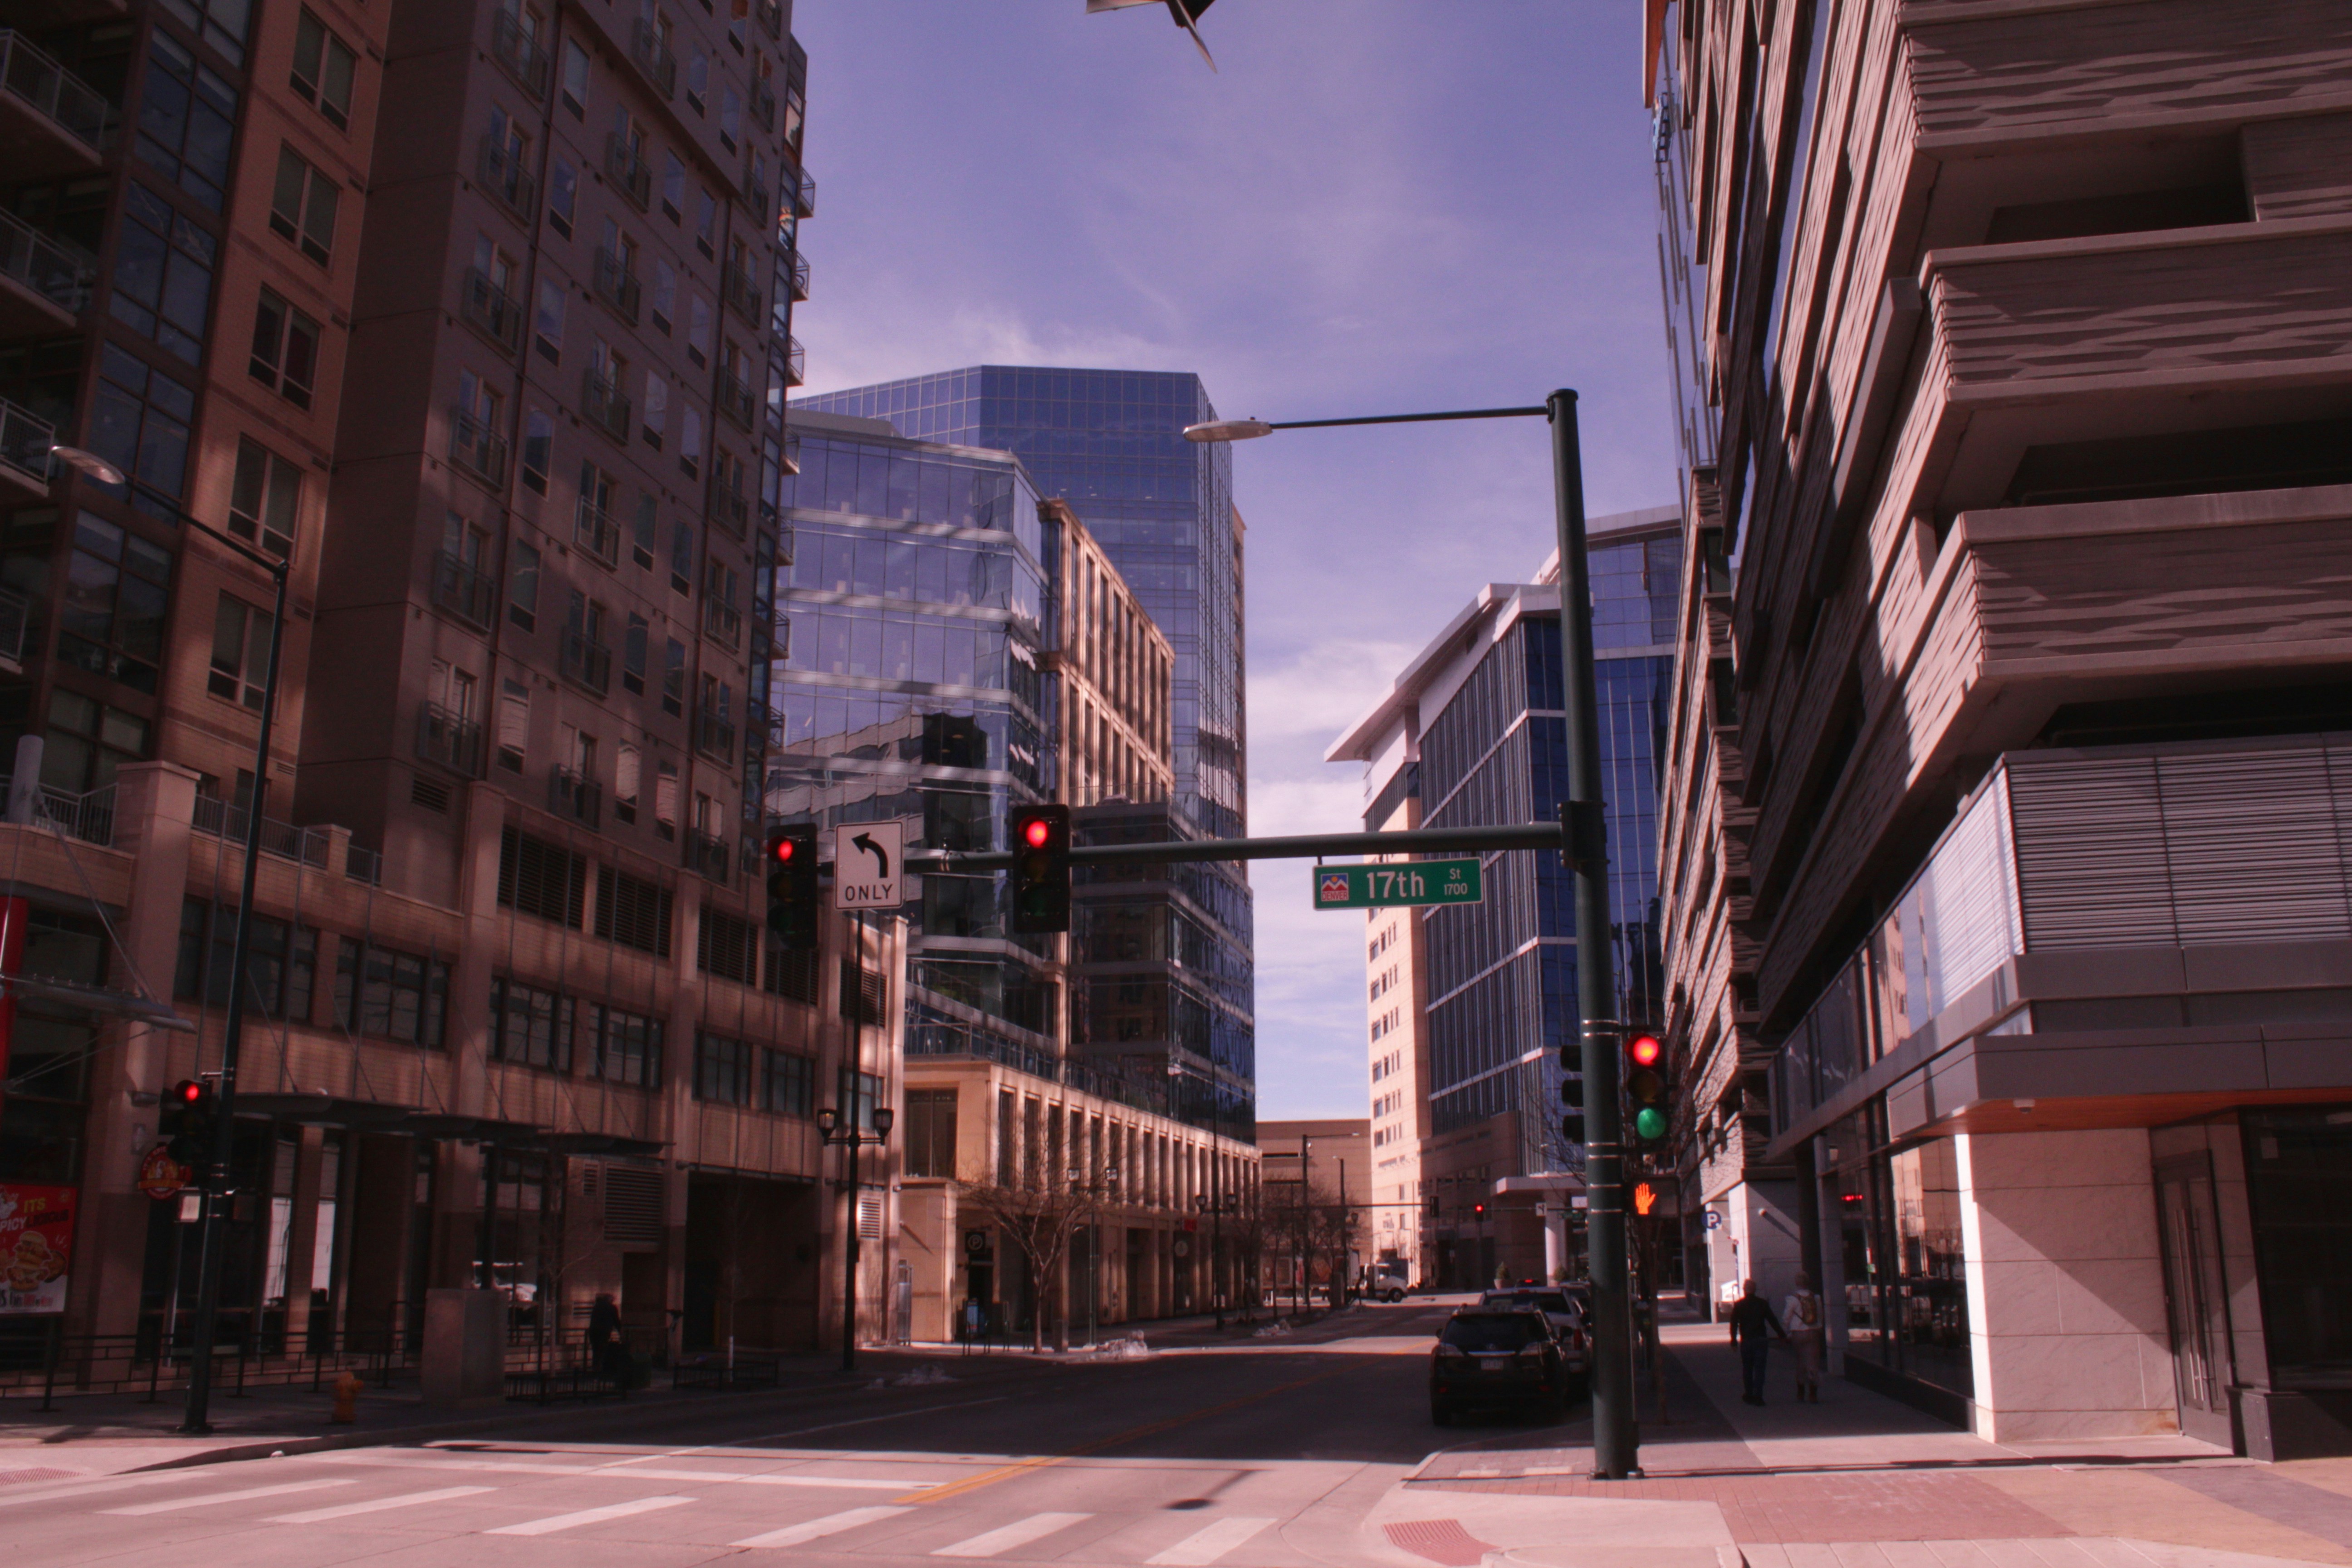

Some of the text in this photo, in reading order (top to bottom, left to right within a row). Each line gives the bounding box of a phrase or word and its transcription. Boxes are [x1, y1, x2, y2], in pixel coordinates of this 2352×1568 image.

[1367, 867, 1461, 899] 17th St
[1444, 883, 1468, 895] 1700
[845, 883, 893, 901] ONLY
[1322, 891, 1348, 901] DENVER
[1707, 1213, 1718, 1227] P
